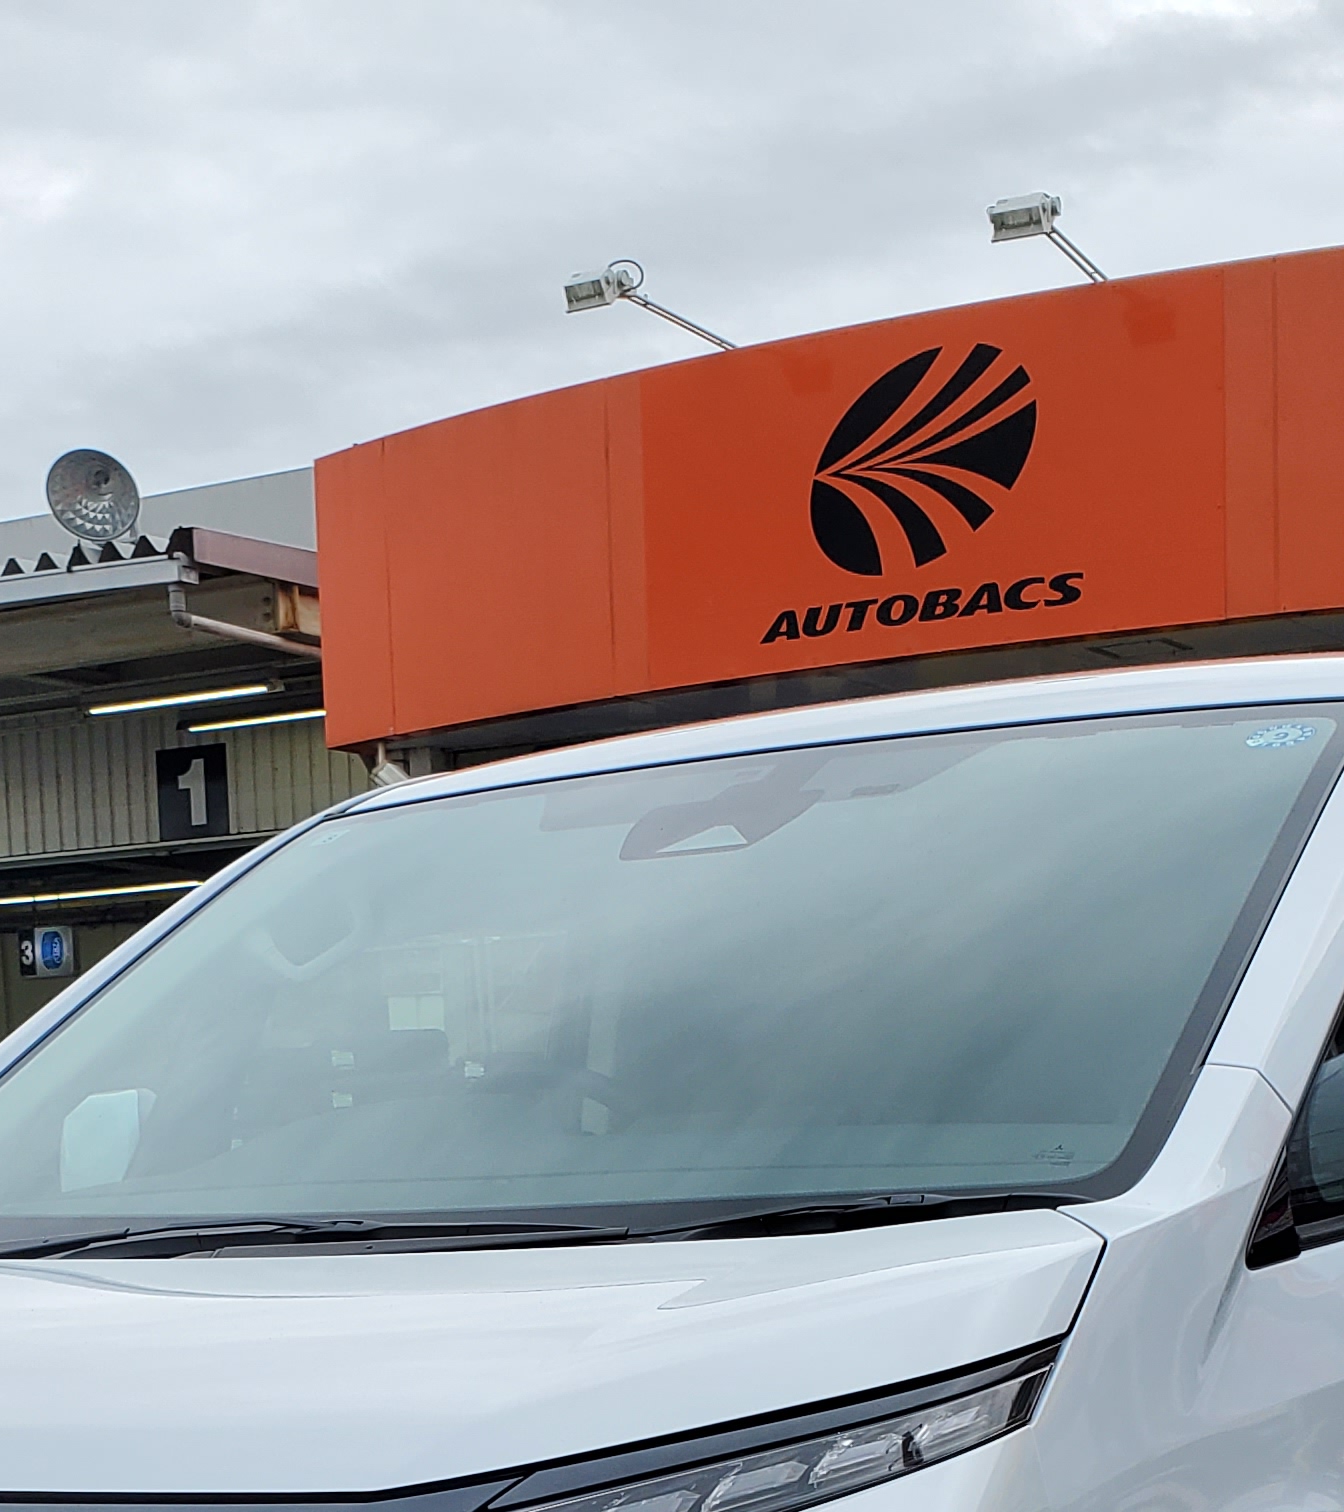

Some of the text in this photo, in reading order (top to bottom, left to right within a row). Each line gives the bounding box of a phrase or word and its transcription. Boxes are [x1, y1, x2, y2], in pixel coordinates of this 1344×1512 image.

[759, 572, 1084, 644] AUTOBACS
[178, 758, 209, 827] 1
[21, 940, 34, 966] 3
